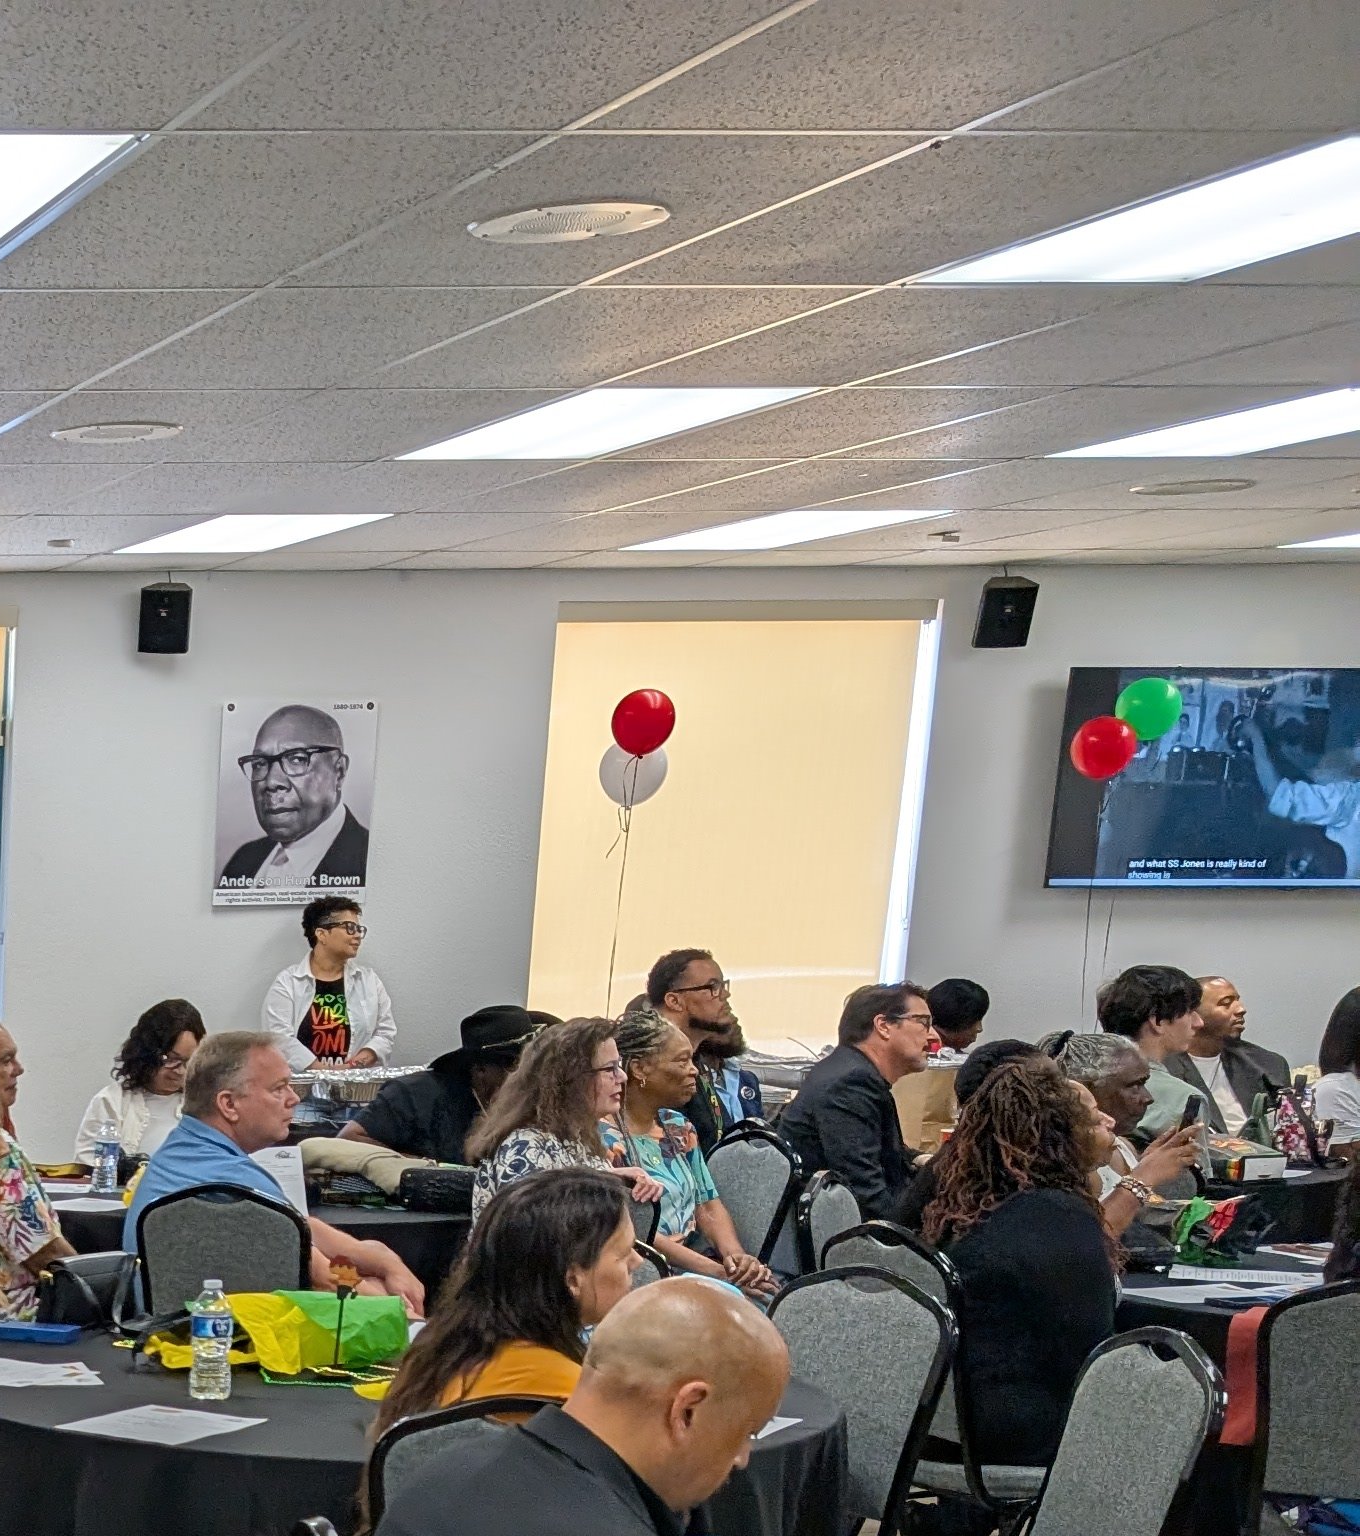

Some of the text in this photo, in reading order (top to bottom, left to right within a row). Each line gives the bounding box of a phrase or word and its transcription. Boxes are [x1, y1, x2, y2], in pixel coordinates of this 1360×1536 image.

[1129, 859, 1145, 868] and
[1146, 859, 1166, 868] what
[1180, 859, 1205, 868] Jones
[1206, 859, 1214, 868] is
[1215, 859, 1237, 870] really
[1238, 859, 1257, 868] kind
[1257, 859, 1268, 868] of
[219, 874, 361, 887] Anderson Hunt Brown
[314, 994, 346, 1006] GOO
[312, 1029, 348, 1056] ONL
